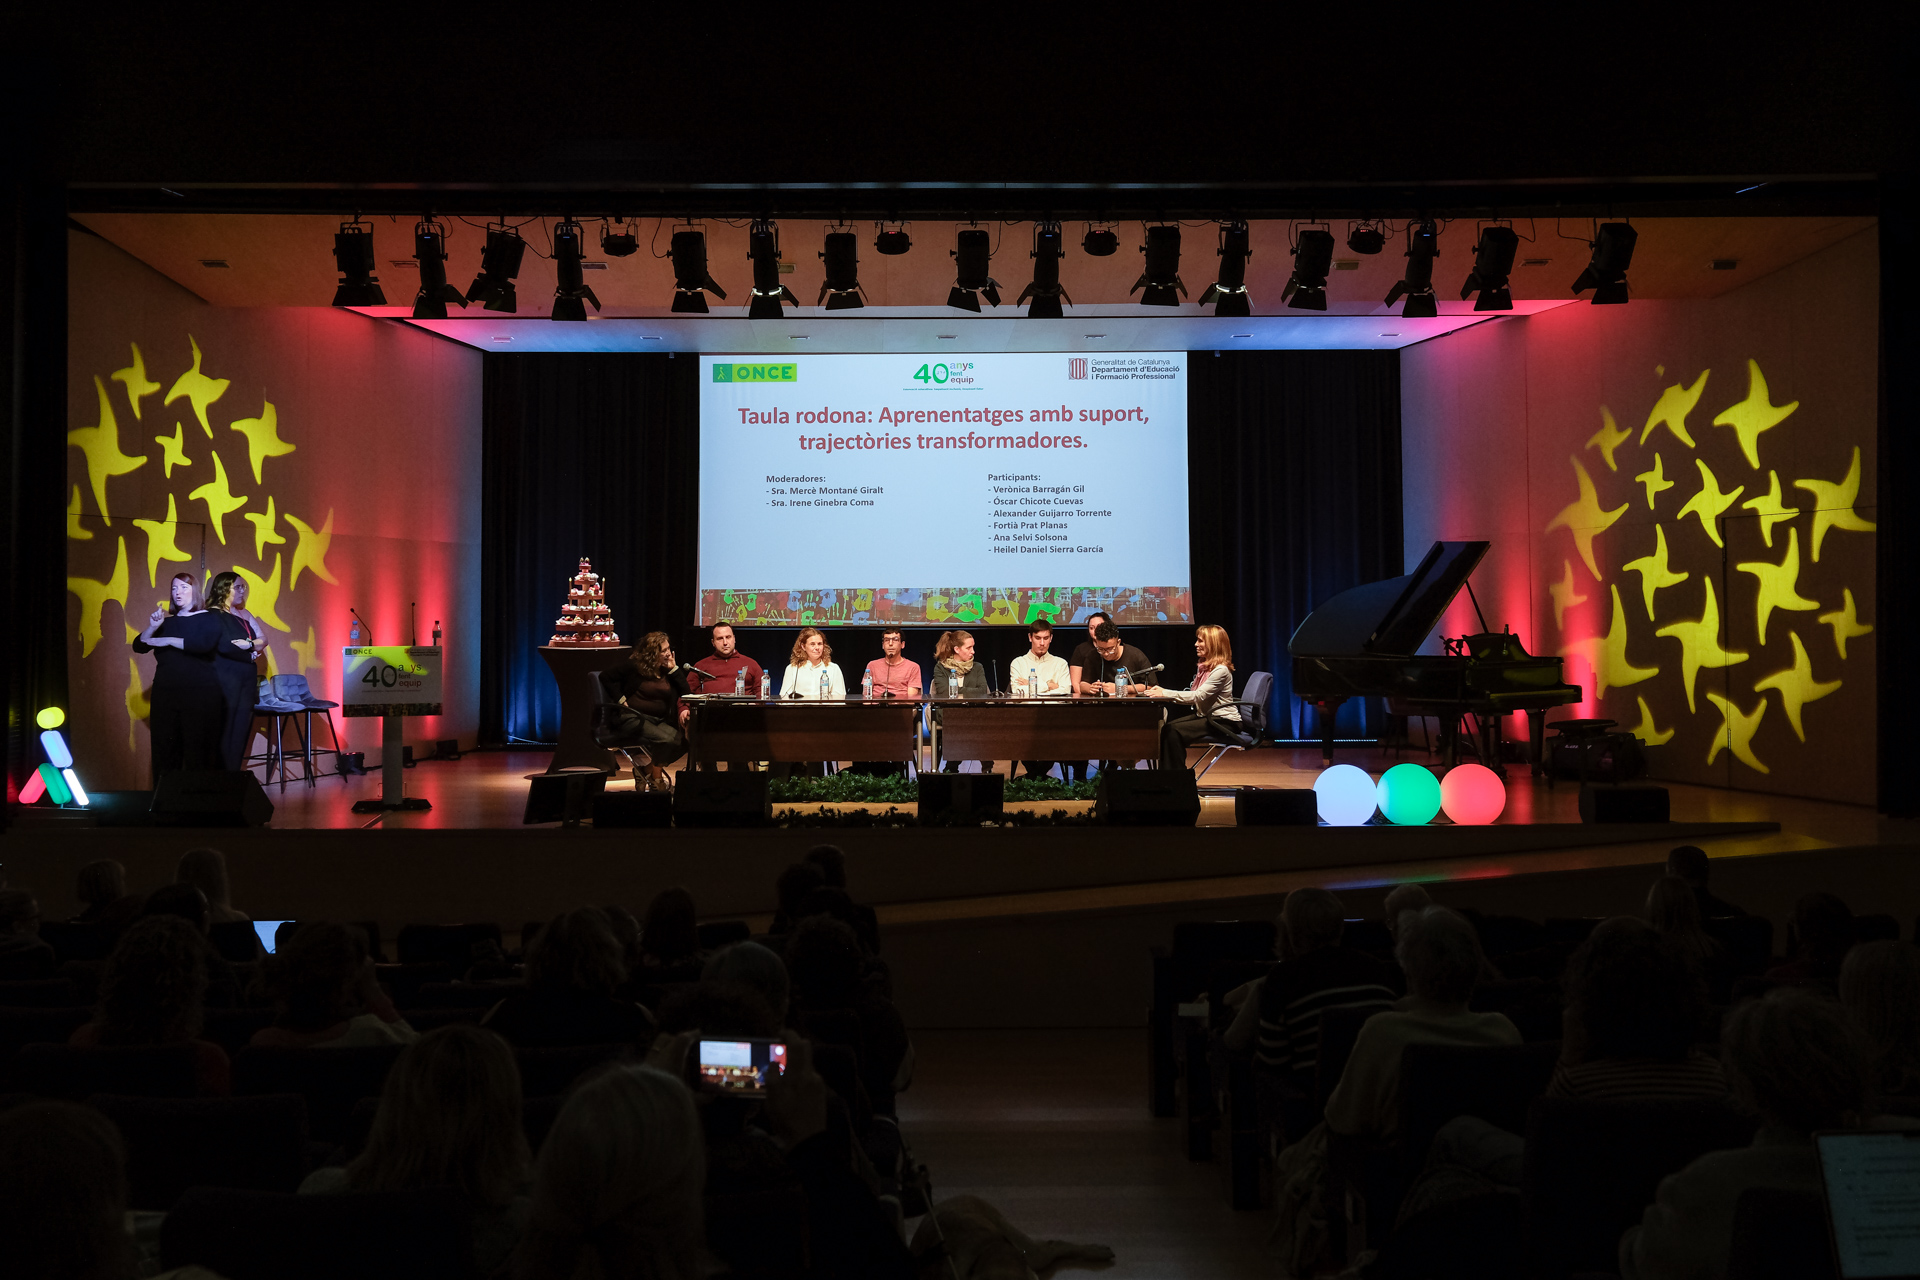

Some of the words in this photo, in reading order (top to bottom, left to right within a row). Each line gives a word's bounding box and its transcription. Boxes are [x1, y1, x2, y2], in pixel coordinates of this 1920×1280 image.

[950, 362, 974, 371] anys
[1138, 359, 1170, 367] Catalunya
[737, 366, 792, 379] ONCE
[913, 363, 949, 384] 40
[1091, 366, 1138, 374] Departament
[950, 376, 974, 385] equip
[738, 407, 790, 424] Taula
[796, 406, 873, 424] rodona:
[878, 407, 1024, 427] Aprenentatges
[1029, 405, 1074, 422] amb
[1079, 406, 1149, 425] suport,
[799, 432, 911, 454] trajectòries
[917, 431, 1088, 449] transformadores.
[987, 474, 1041, 482] Participants:
[789, 486, 817, 494] Mercè
[860, 486, 884, 494] Giralt
[993, 485, 1030, 493] Verònica
[1032, 485, 1071, 494] Barragán
[1073, 485, 1085, 493] Gil
[771, 499, 788, 507] Sra.
[789, 499, 812, 507] Irene
[814, 499, 848, 507] Ginebra
[993, 496, 1017, 505] Óscar
[1019, 497, 1051, 505] Chicote
[1053, 497, 1084, 505] Cuevas
[1038, 510, 1074, 518] Guijarro
[1076, 509, 1112, 517] Torrente
[1012, 533, 1033, 541] Selvi
[1034, 533, 1068, 541] Solsona
[1076, 545, 1104, 553] García
[398, 664, 422, 673] ays
[362, 665, 397, 687] 40
[398, 680, 422, 688] equip
